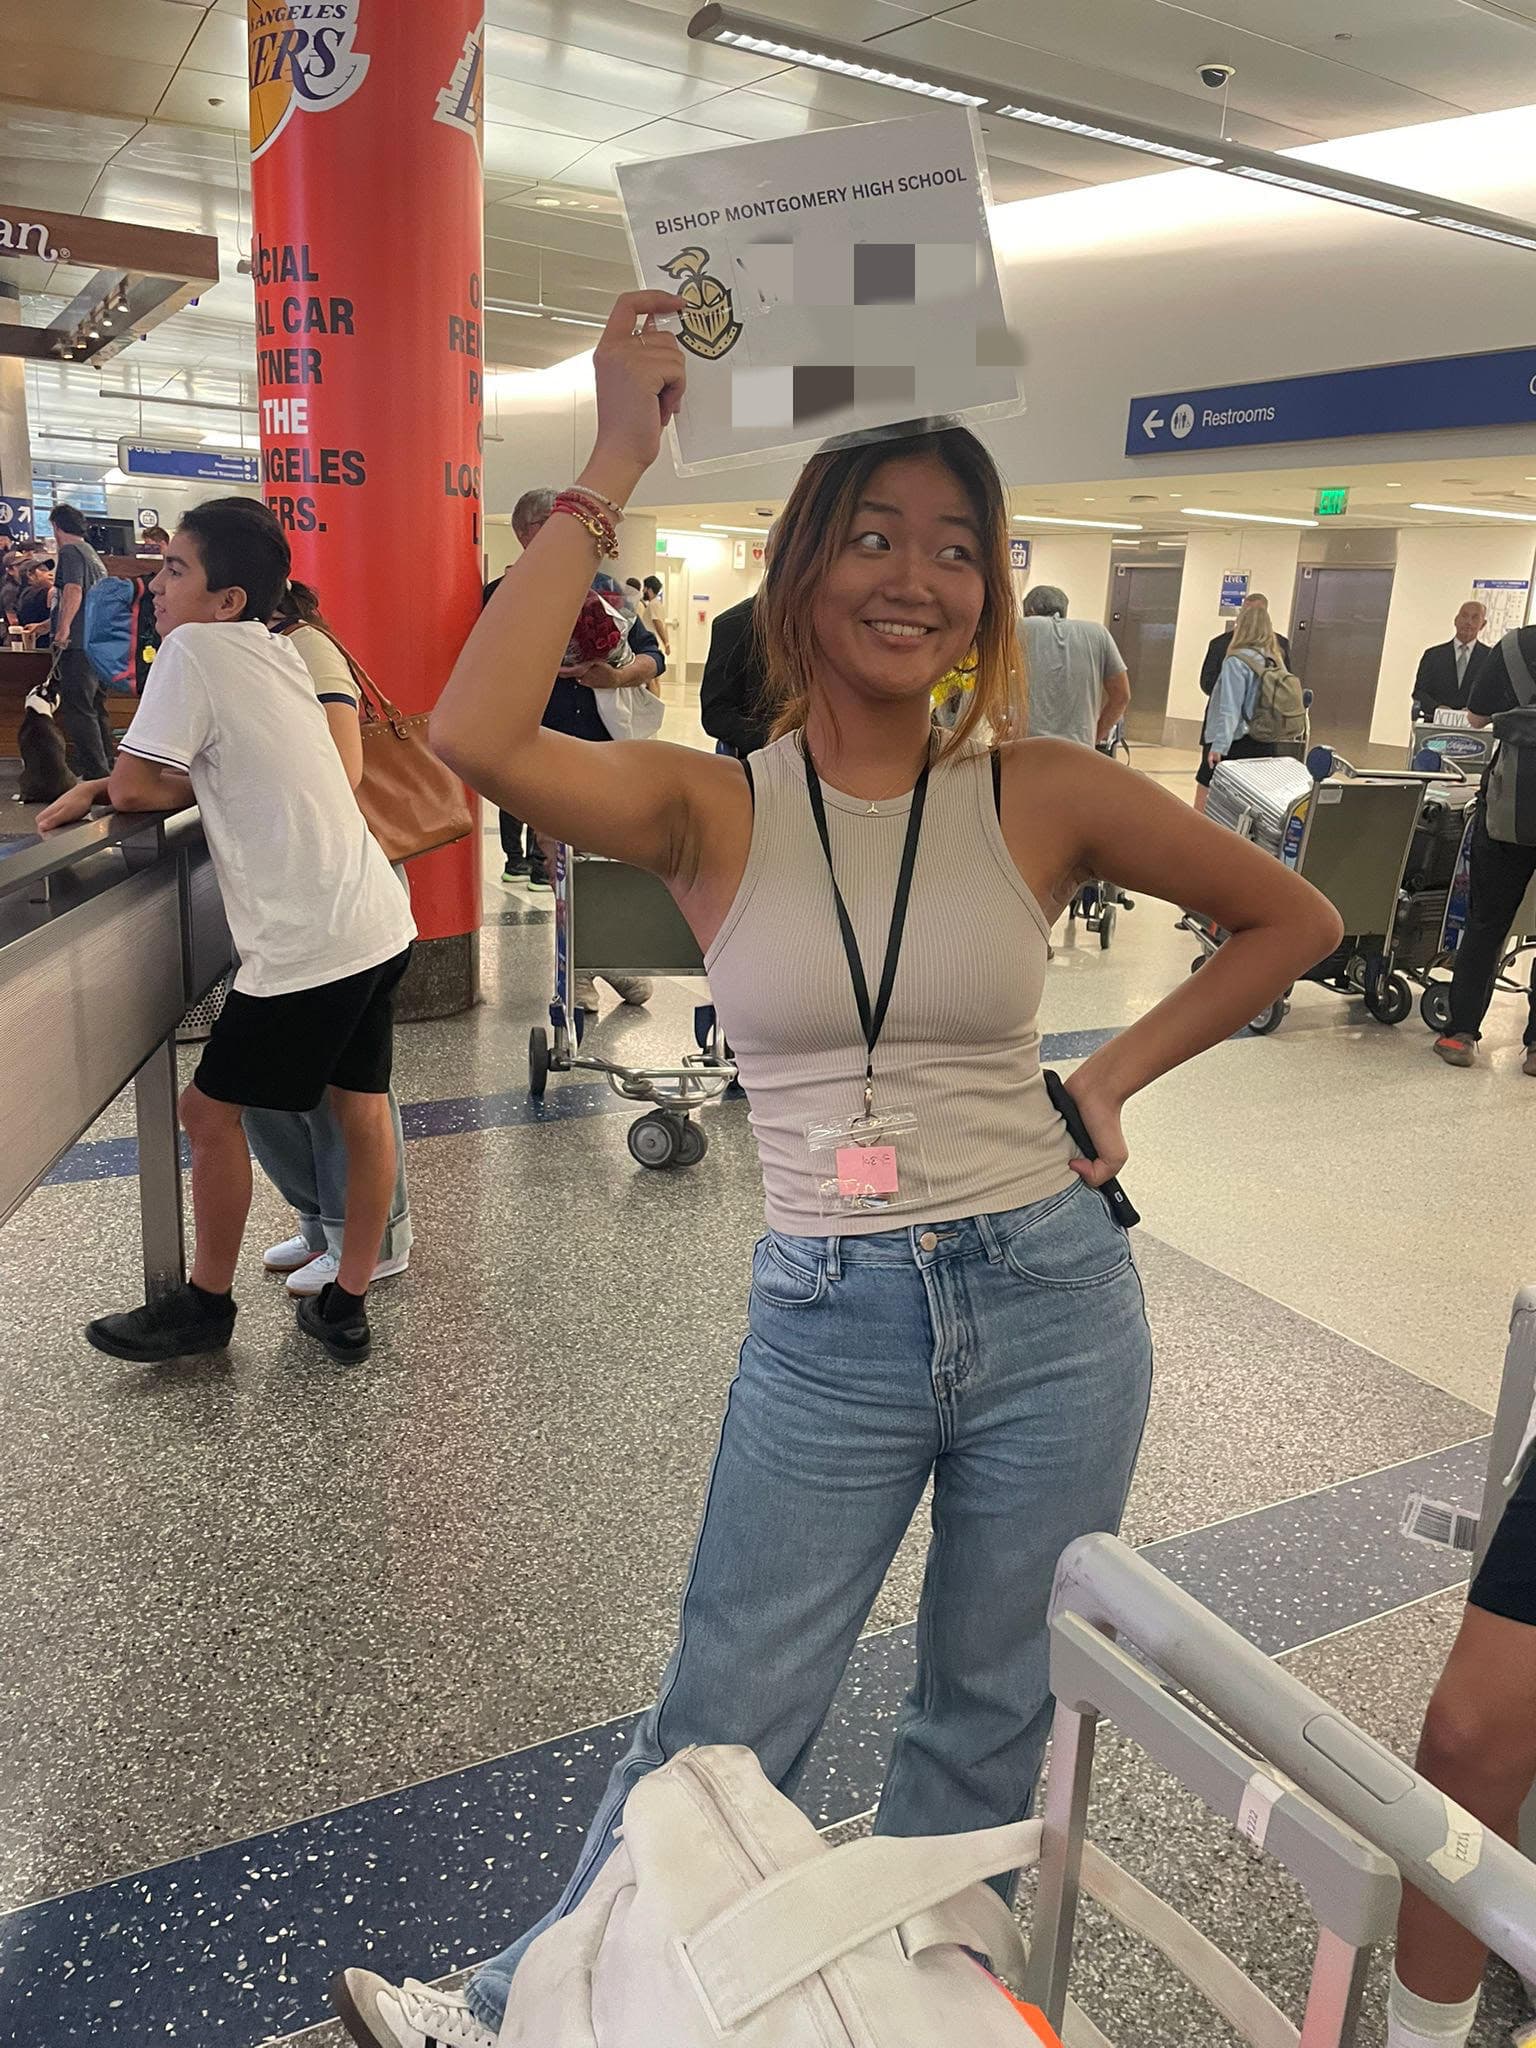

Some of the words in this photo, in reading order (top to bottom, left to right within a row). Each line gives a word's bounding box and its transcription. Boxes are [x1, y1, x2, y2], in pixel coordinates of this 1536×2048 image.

[256, 4, 348, 29] ANGELES
[250, 27, 358, 101] ERS
[655, 210, 722, 236] BISHOP
[725, 186, 848, 223] MONTGOMERY
[852, 179, 895, 201] HIGH
[898, 167, 968, 193] SCHOOL
[282, 296, 355, 336] CAR
[257, 348, 323, 388] TNER
[262, 398, 309, 435] THE
[1202, 406, 1276, 428] Restrooms
